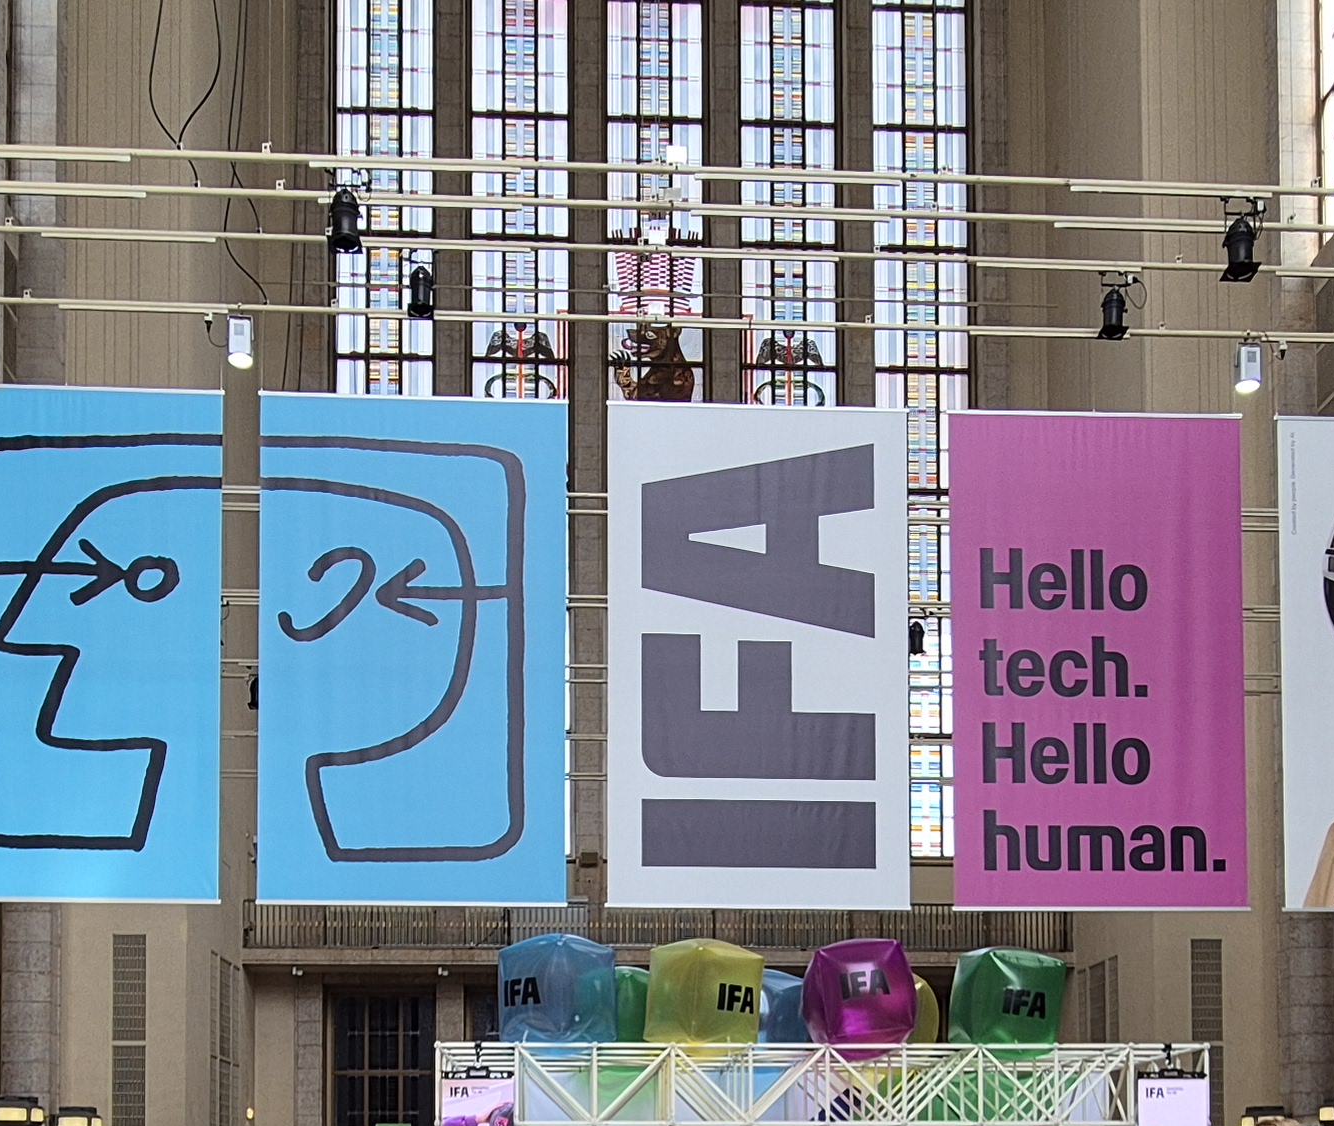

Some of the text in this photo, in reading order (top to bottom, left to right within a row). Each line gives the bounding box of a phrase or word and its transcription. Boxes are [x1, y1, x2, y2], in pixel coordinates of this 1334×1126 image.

[980, 548, 1148, 611] Hello
[641, 443, 876, 869] IFA
[979, 636, 1148, 697] tech.
[982, 722, 1151, 785] Hello
[983, 809, 1226, 872] human.
[504, 977, 541, 1007] IFA
[717, 983, 754, 1014] IFA
[840, 970, 890, 1000] IFA
[1002, 988, 1046, 1019] IFA
[450, 1087, 469, 1098] IFA
[1146, 1087, 1164, 1099] IFA
